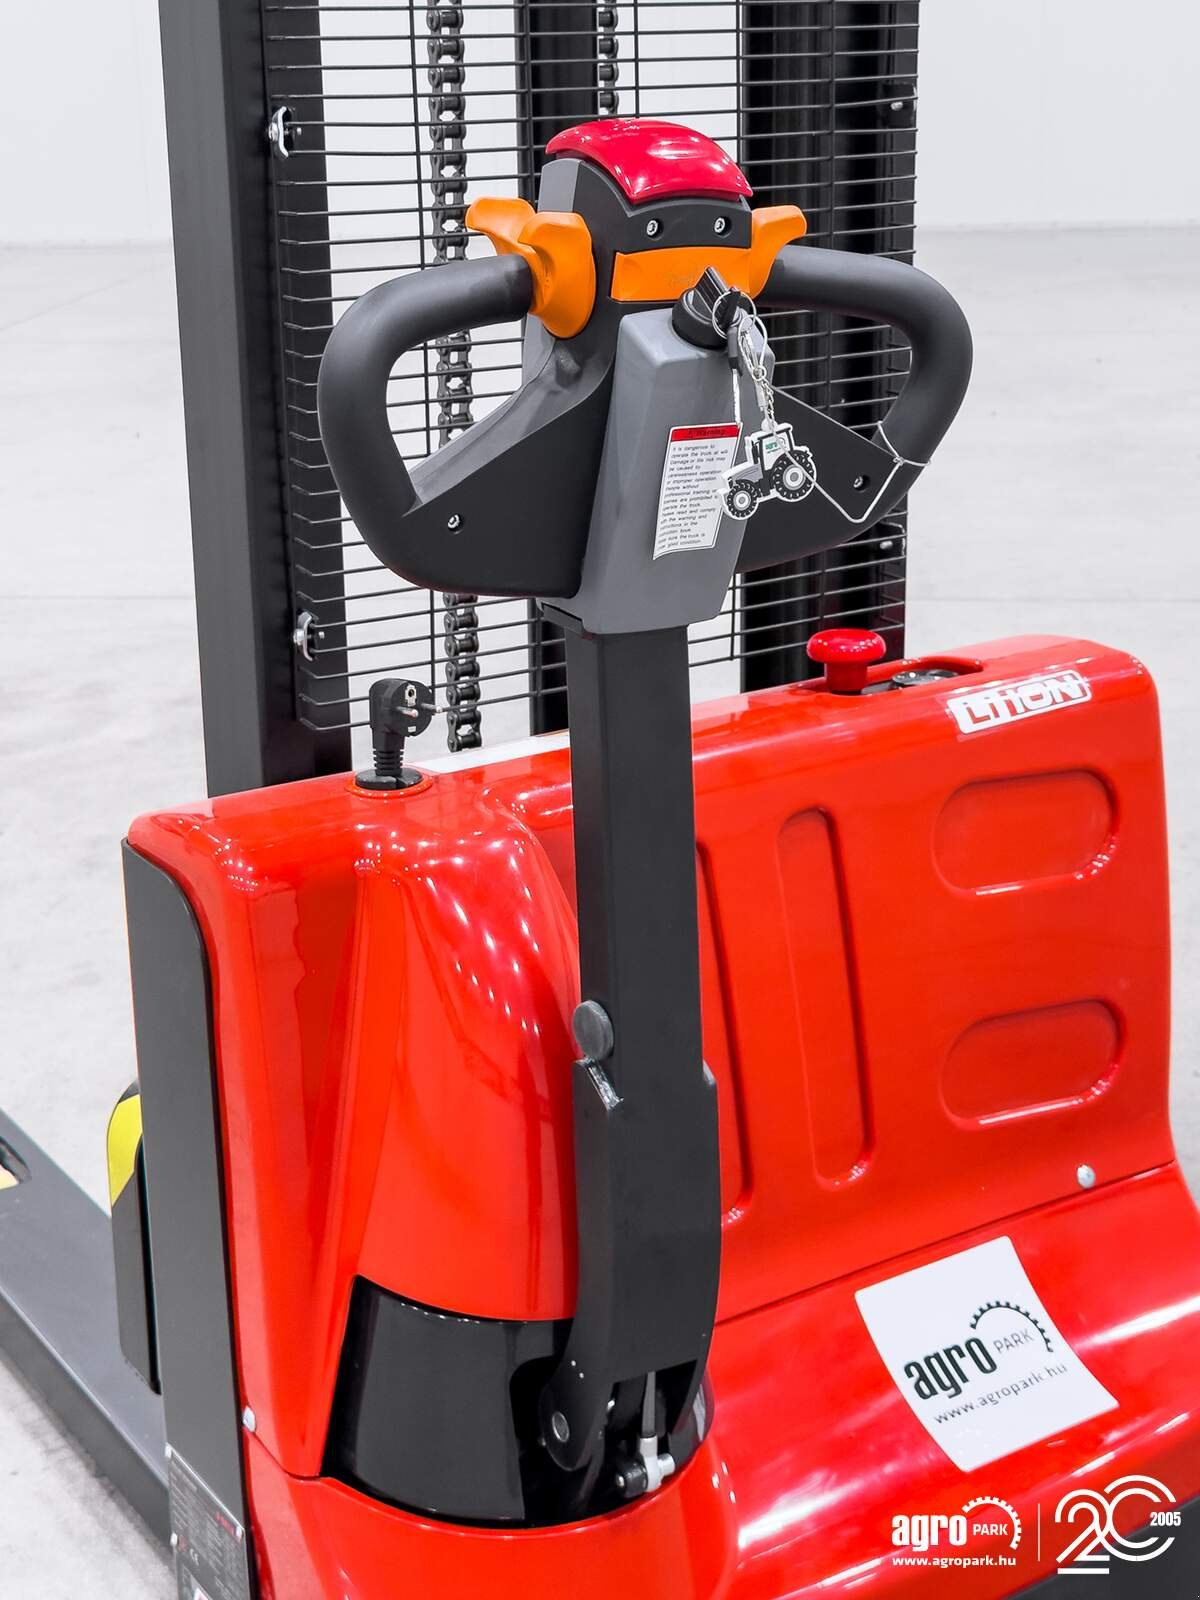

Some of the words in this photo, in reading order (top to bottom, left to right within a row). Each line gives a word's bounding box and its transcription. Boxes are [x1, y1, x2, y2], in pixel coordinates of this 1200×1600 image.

[904, 1338, 998, 1400] agro
[993, 1329, 1034, 1354] PARK
[935, 1364, 1068, 1424] www.agropark.hu
